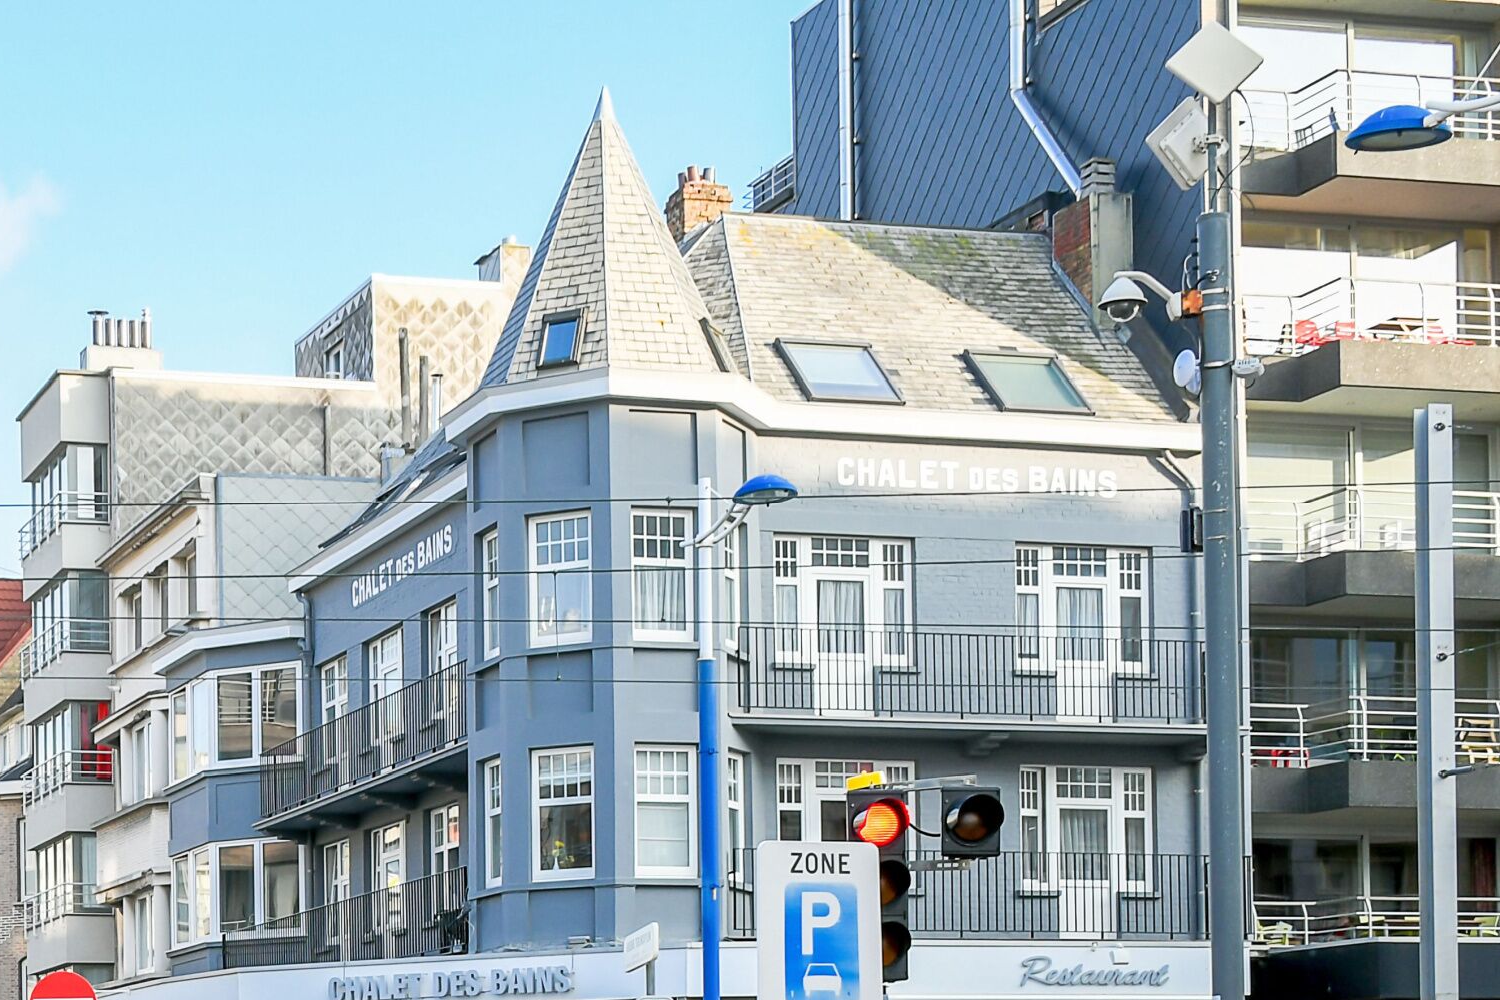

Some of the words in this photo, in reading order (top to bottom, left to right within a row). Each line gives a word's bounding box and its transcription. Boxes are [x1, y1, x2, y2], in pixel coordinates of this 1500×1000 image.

[836, 457, 959, 489] CHALET
[968, 466, 1020, 491] DES
[1028, 466, 1118, 498] BAINS
[352, 559, 394, 608] CHALET
[395, 551, 415, 582] DES
[417, 524, 453, 569] BAINS
[789, 852, 851, 874] ZONE
[801, 891, 841, 956] P
[433, 969, 484, 998] DES
[491, 965, 575, 995] BAINS
[1019, 955, 1169, 988] Restaurant
